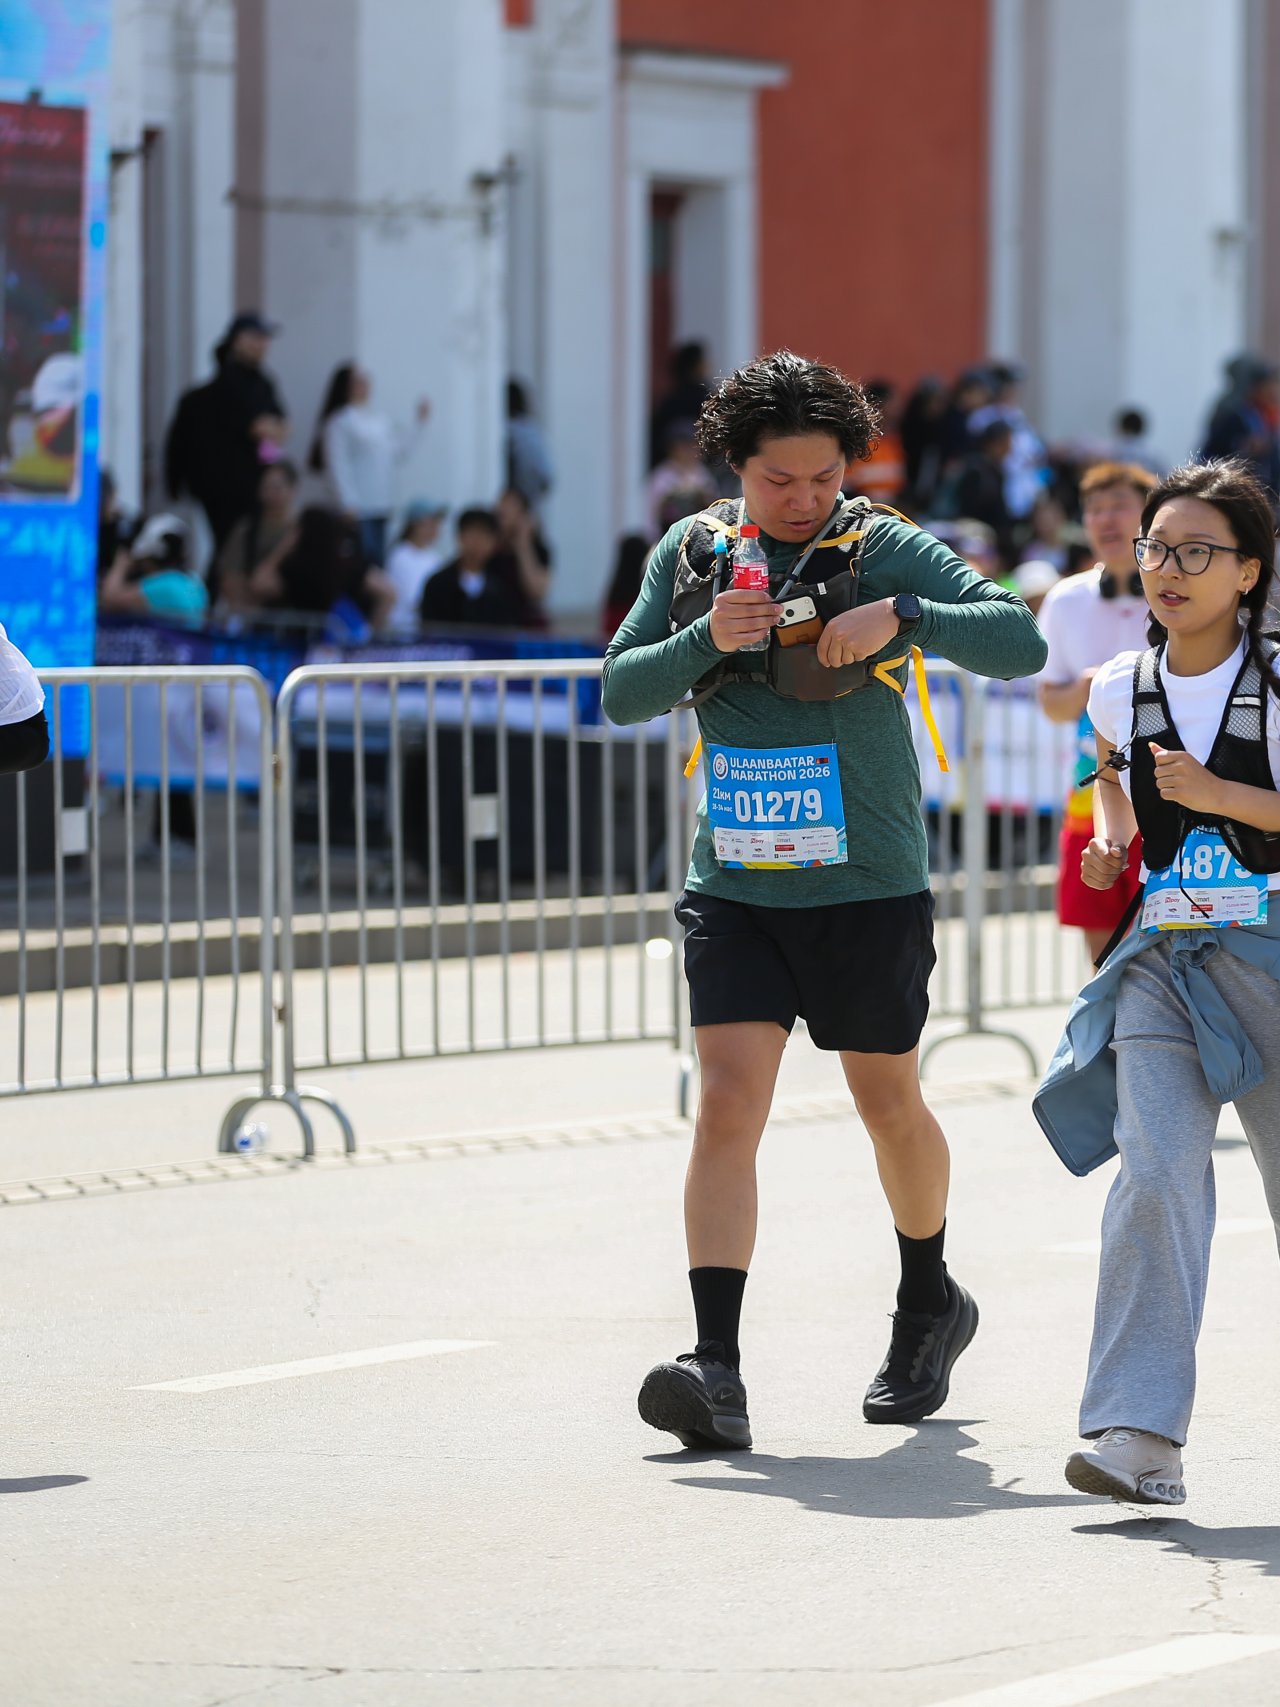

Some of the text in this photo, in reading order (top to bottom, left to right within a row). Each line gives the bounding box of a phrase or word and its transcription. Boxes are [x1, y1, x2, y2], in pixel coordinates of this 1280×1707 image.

[730, 755, 815, 769] ULAANBAATAR
[730, 766, 831, 781] MARATHON 2026
[734, 788, 823, 823] 01279
